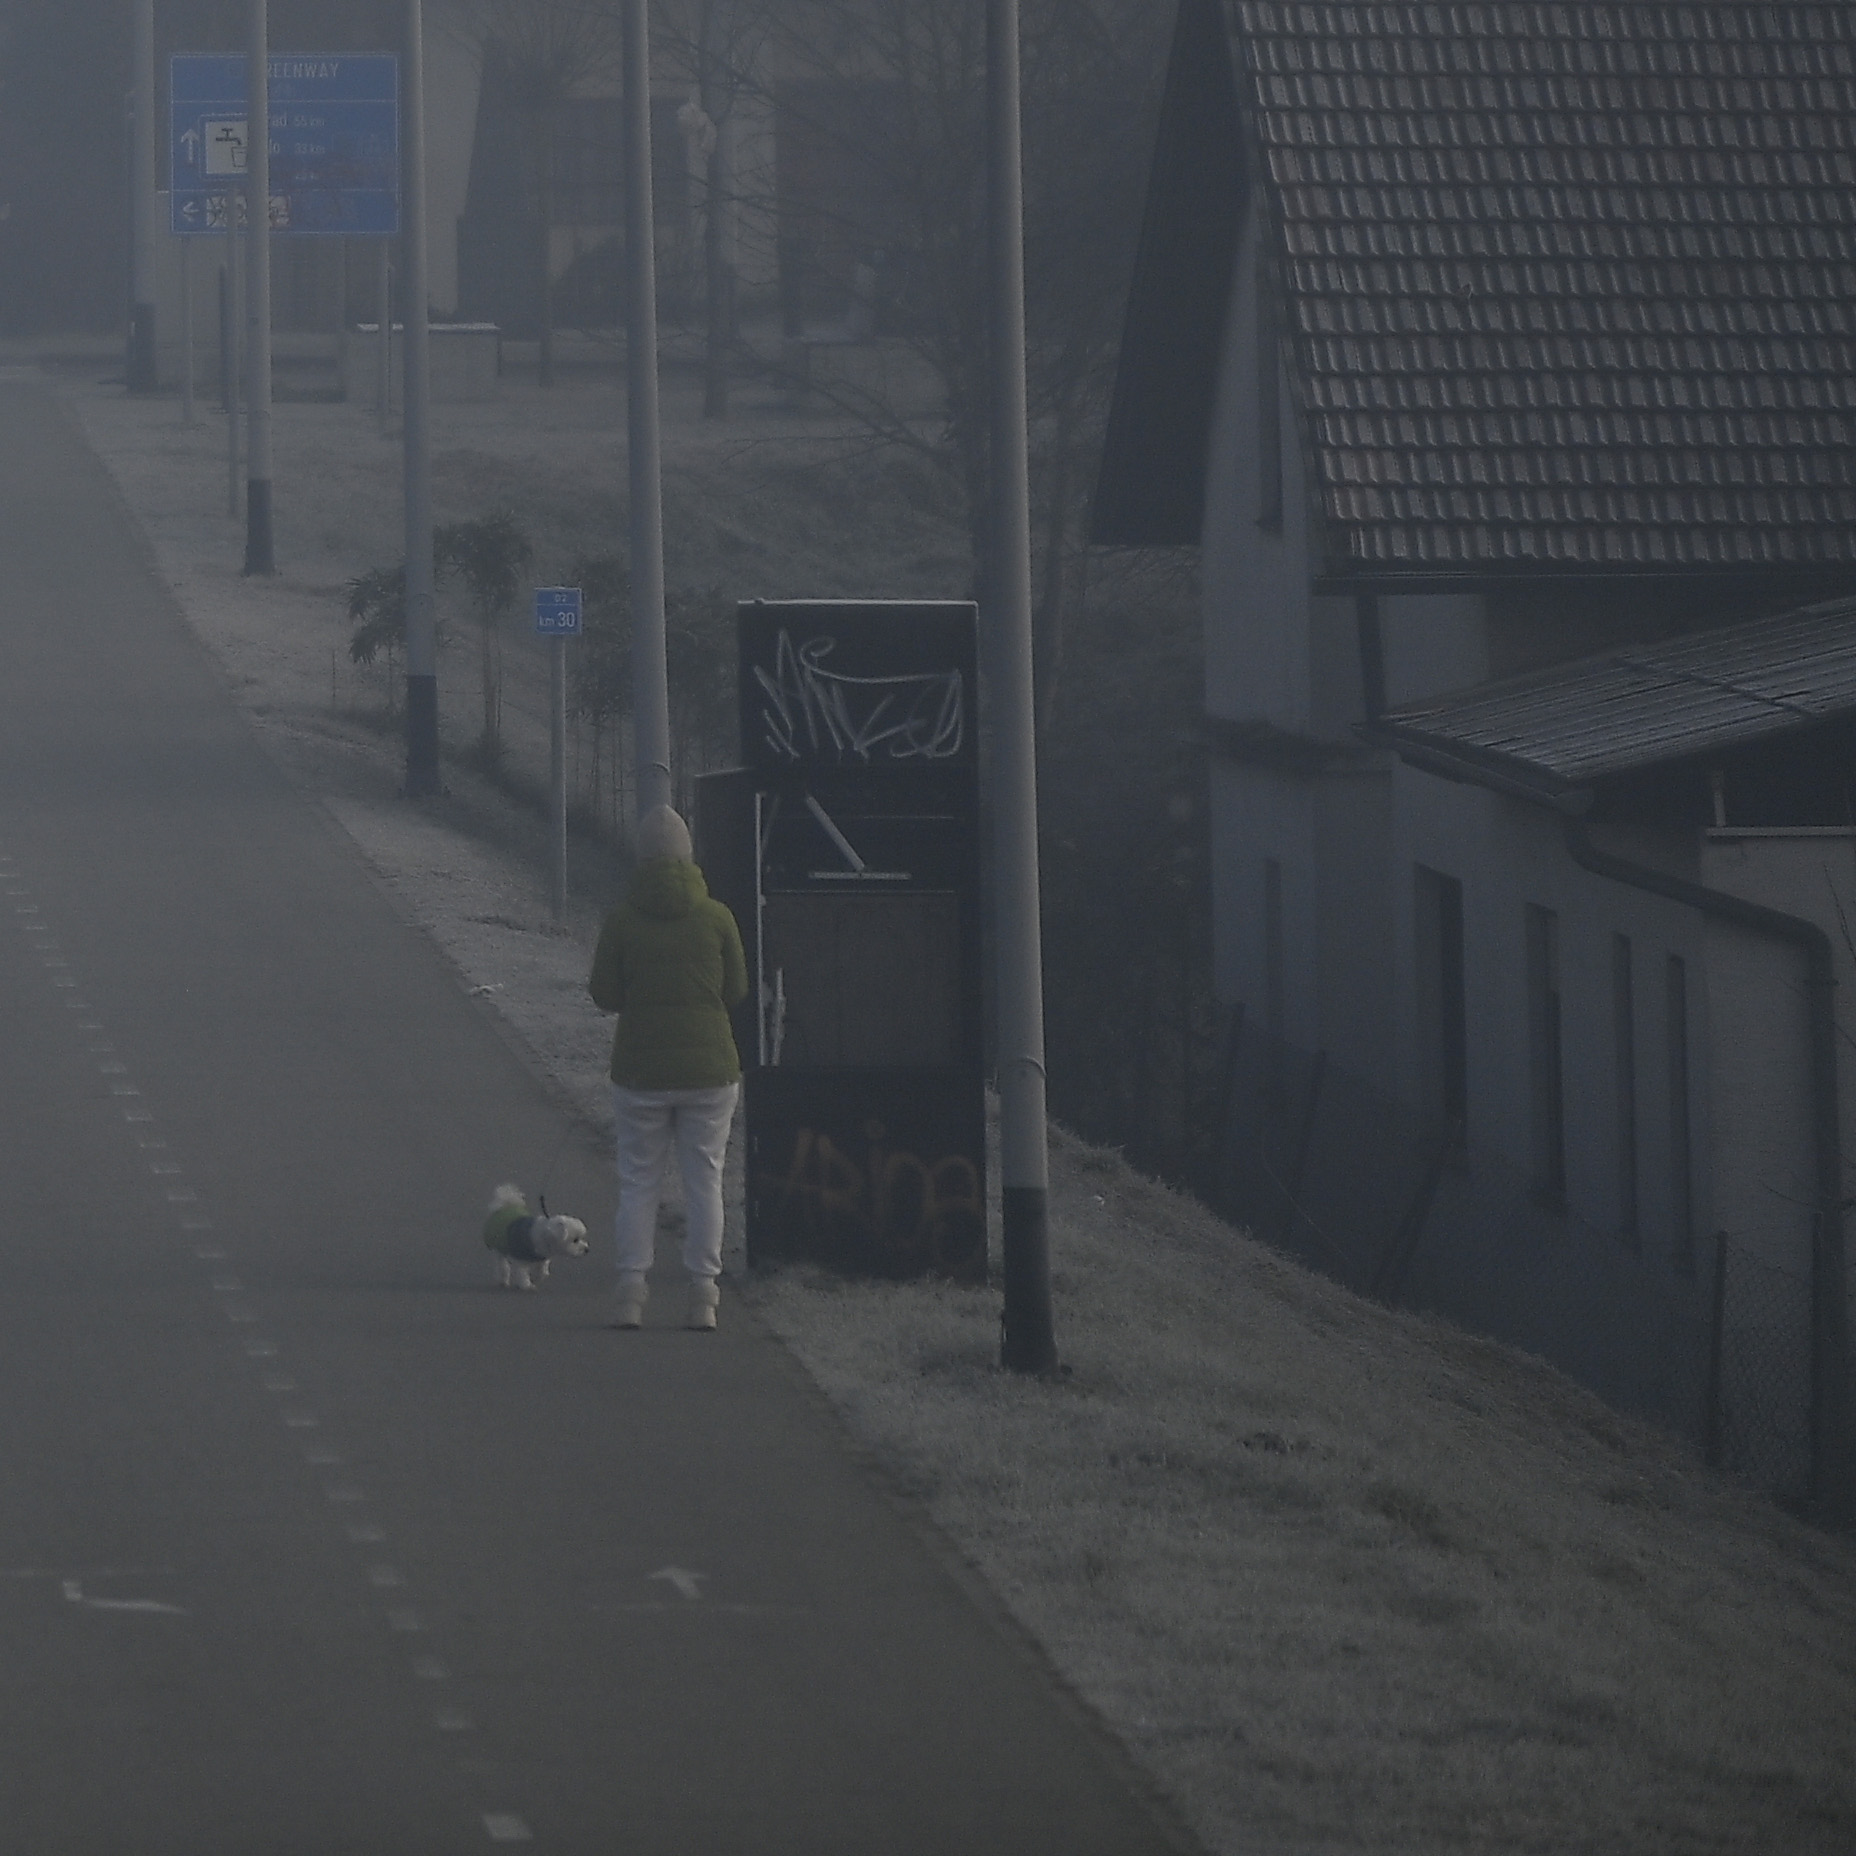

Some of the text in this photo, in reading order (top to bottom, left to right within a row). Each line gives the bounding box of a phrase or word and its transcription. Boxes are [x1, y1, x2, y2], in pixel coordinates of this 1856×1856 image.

[267, 61, 339, 79] REENWAY
[538, 611, 576, 627] km 30
